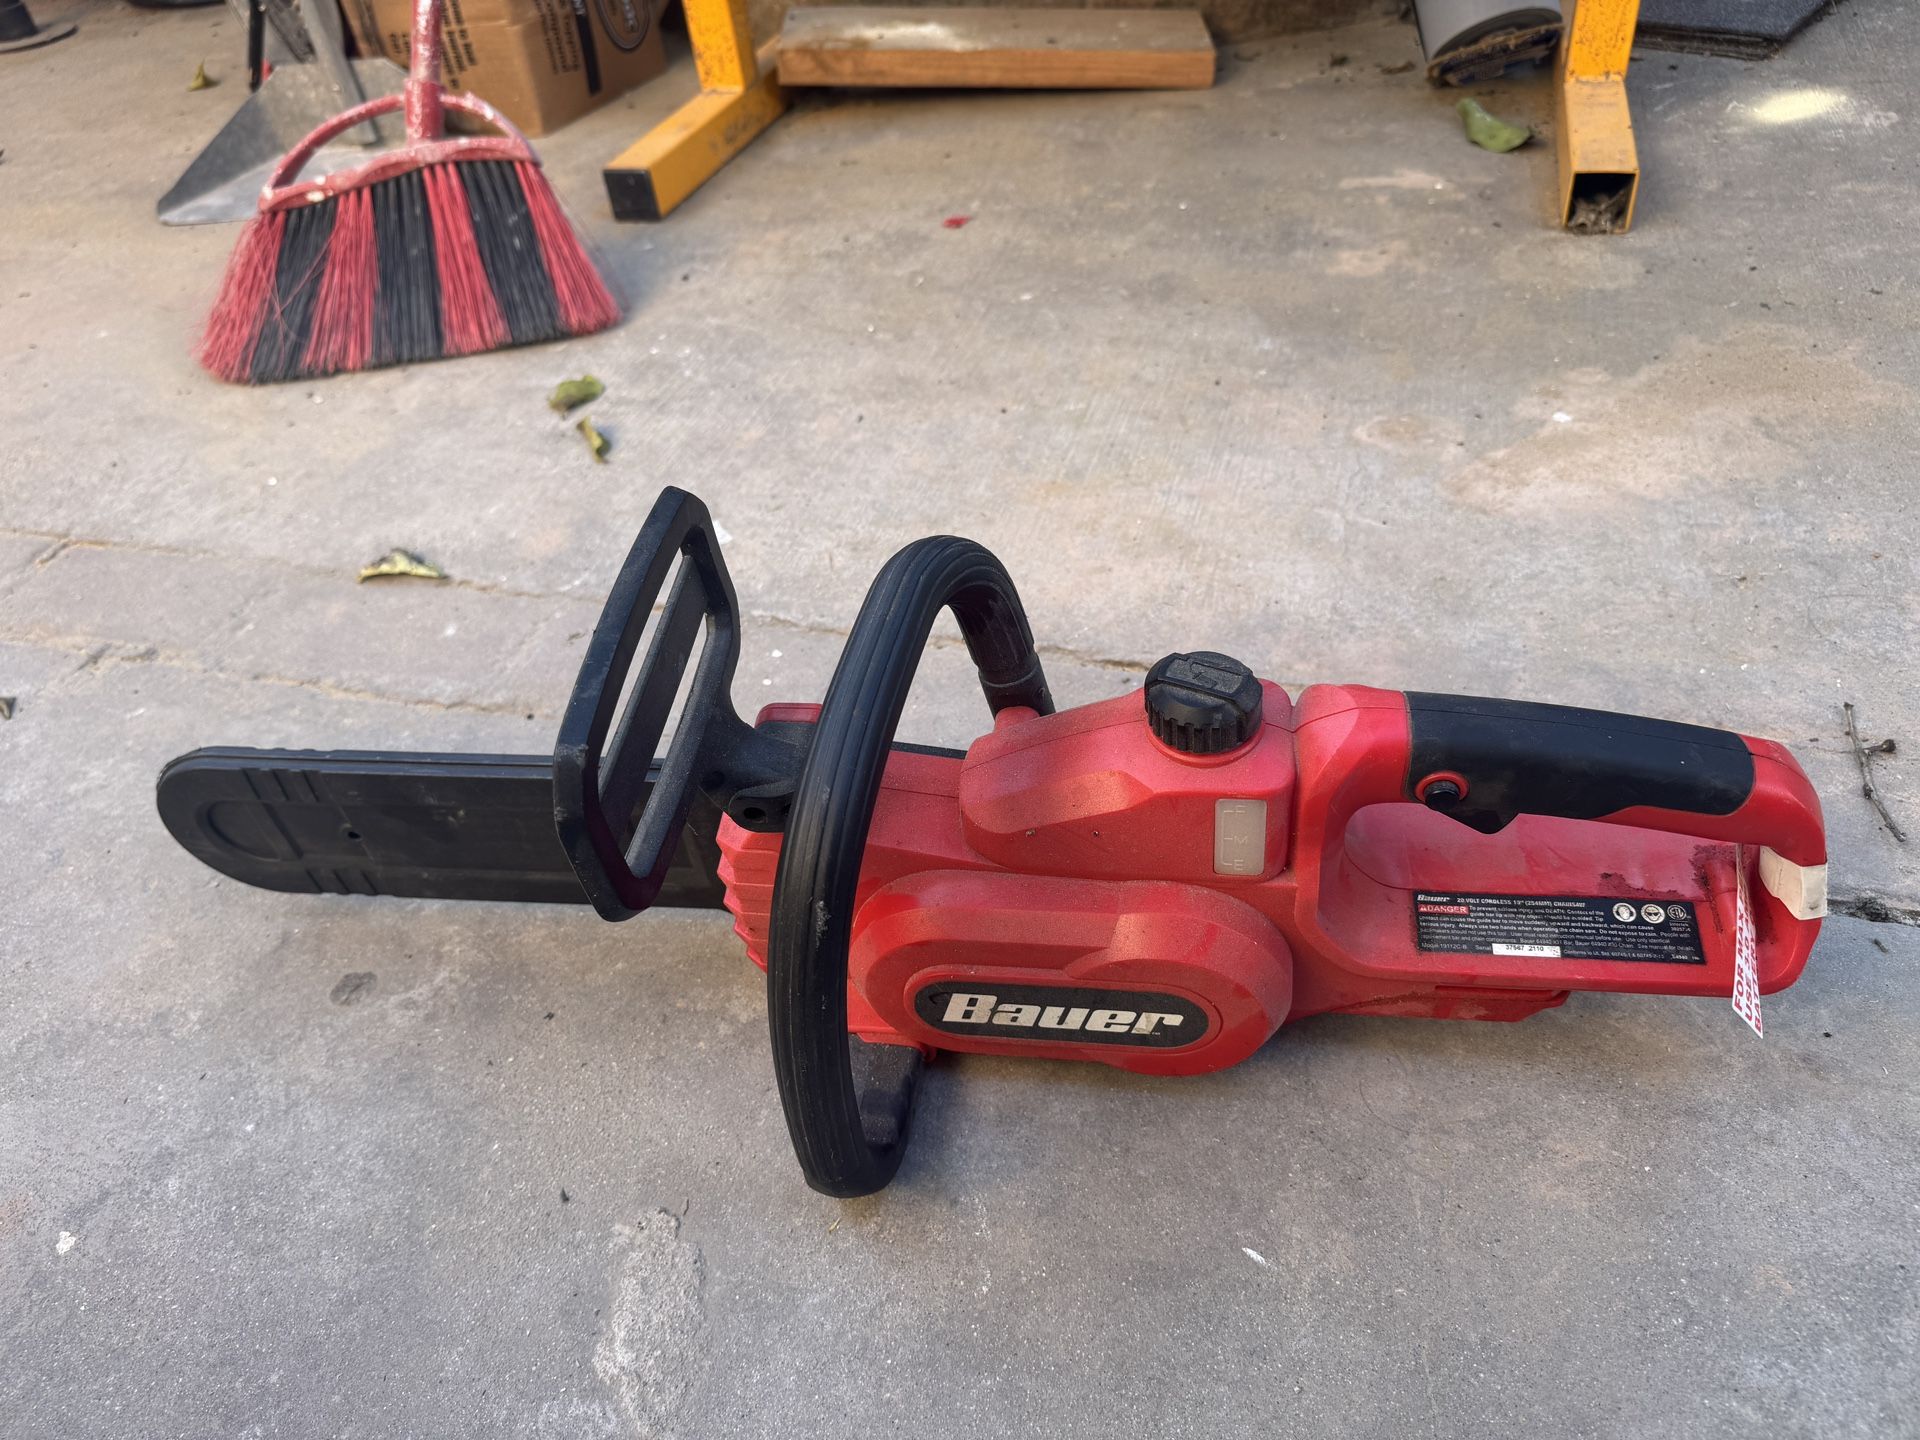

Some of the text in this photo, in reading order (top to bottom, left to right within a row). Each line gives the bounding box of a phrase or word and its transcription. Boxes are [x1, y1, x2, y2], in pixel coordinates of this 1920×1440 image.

[1234, 859, 1244, 871] E
[1417, 894, 1450, 902] Bauer
[1427, 905, 1467, 913] DANGER
[1734, 963, 1744, 1012] FOR
[1745, 973, 1753, 1022] USE
[1750, 931, 1762, 1033] BATTERY
[943, 992, 1184, 1035] Bauer
